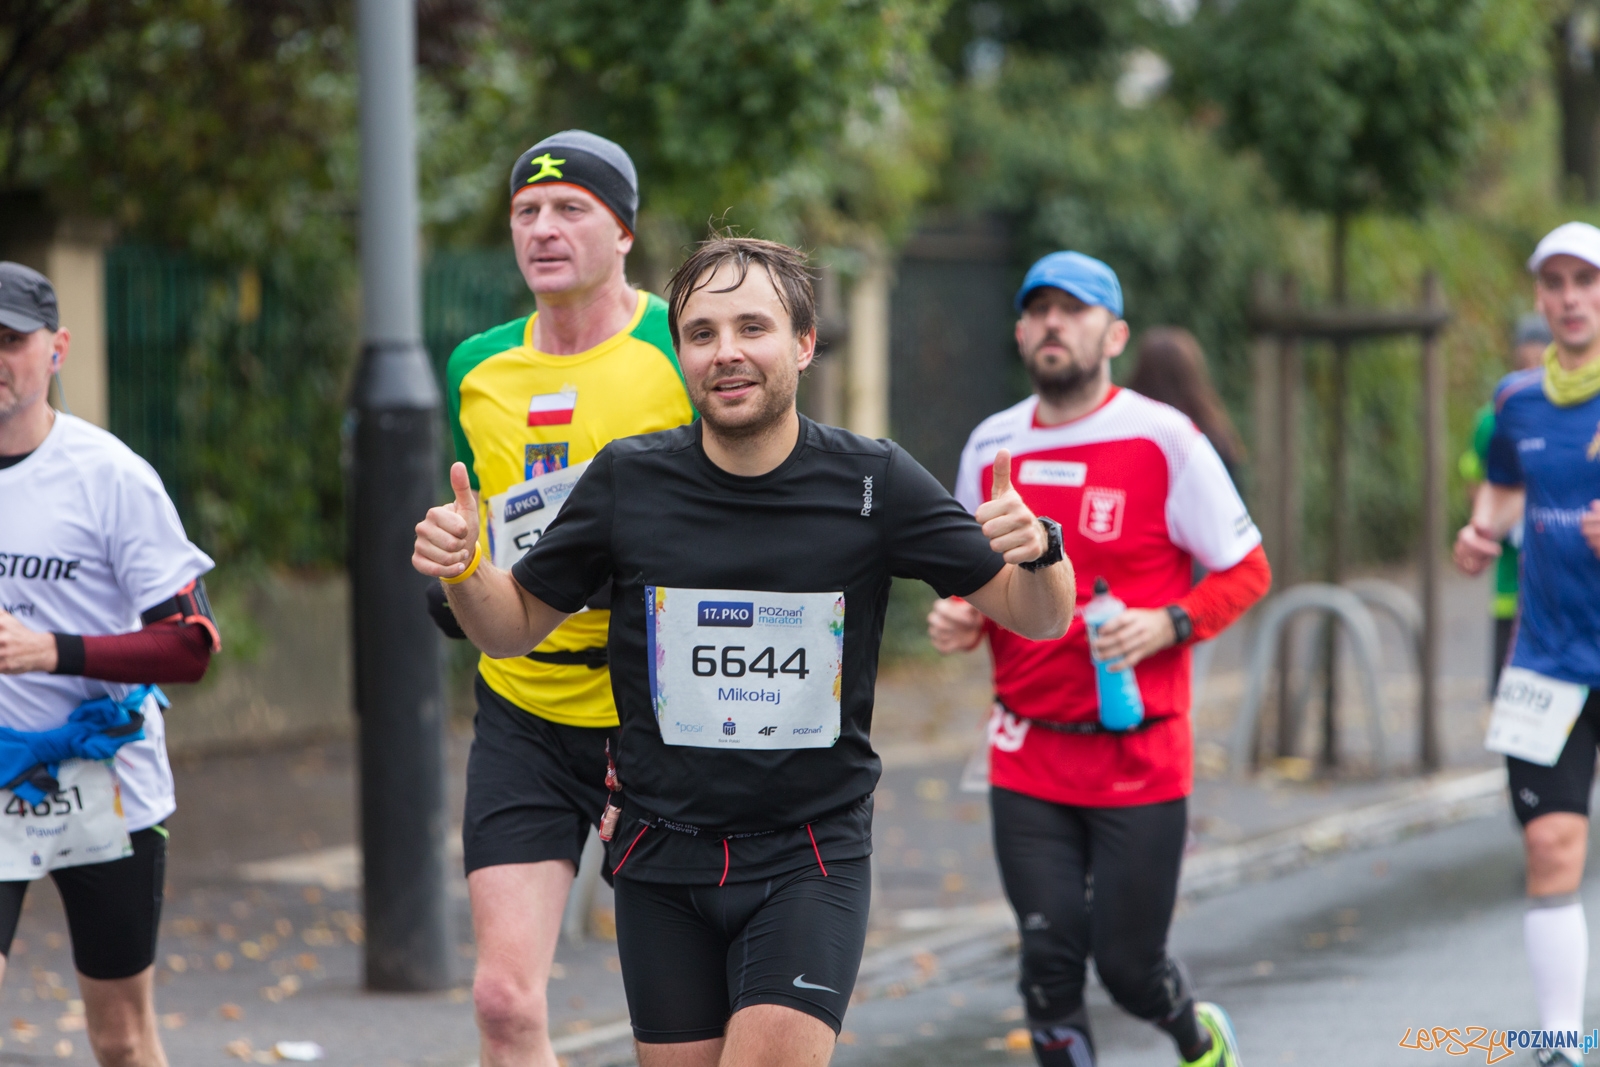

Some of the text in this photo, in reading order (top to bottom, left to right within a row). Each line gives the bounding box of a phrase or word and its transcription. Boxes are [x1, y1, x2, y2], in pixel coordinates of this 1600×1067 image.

[515, 495, 540, 513] PKO
[861, 475, 873, 517] Reebok
[703, 608, 749, 621] 17. PKO
[758, 616, 803, 625] maraton
[692, 645, 810, 680] 6644
[718, 687, 781, 705] Mikołaj
[758, 726, 778, 736] 4F
[664, 822, 699, 837] recovery
